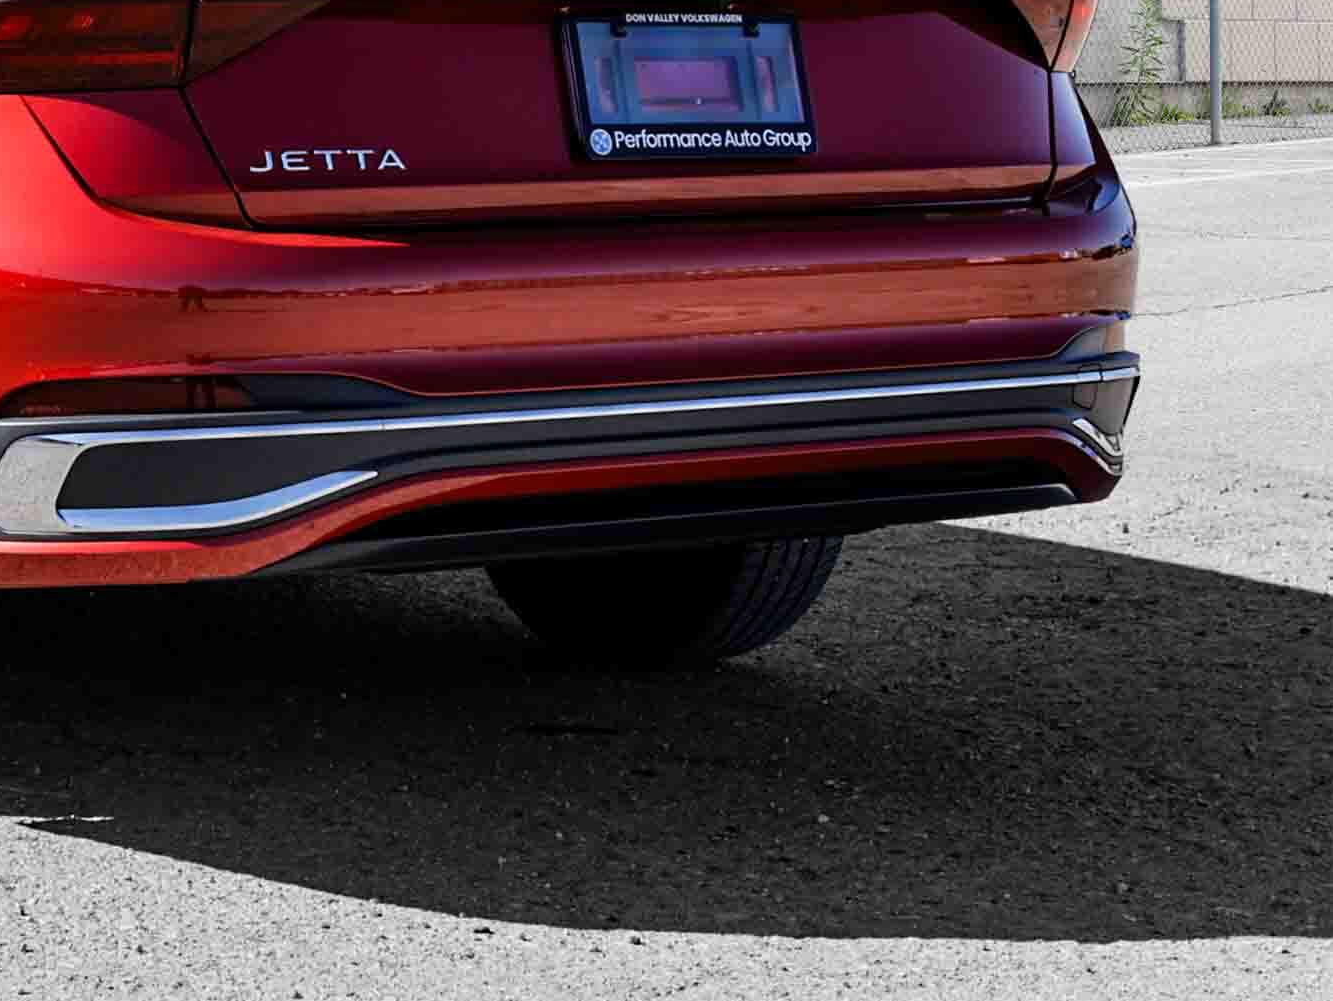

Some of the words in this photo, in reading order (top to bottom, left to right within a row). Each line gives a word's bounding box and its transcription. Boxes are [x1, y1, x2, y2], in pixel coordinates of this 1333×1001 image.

[625, 13, 646, 23] DON
[647, 13, 679, 23] VALLEY
[680, 13, 743, 23] VOLKSWAGEN
[614, 129, 722, 149] Performance
[724, 129, 762, 147] Auto
[763, 128, 812, 152] Group
[249, 149, 408, 173] JETTA
